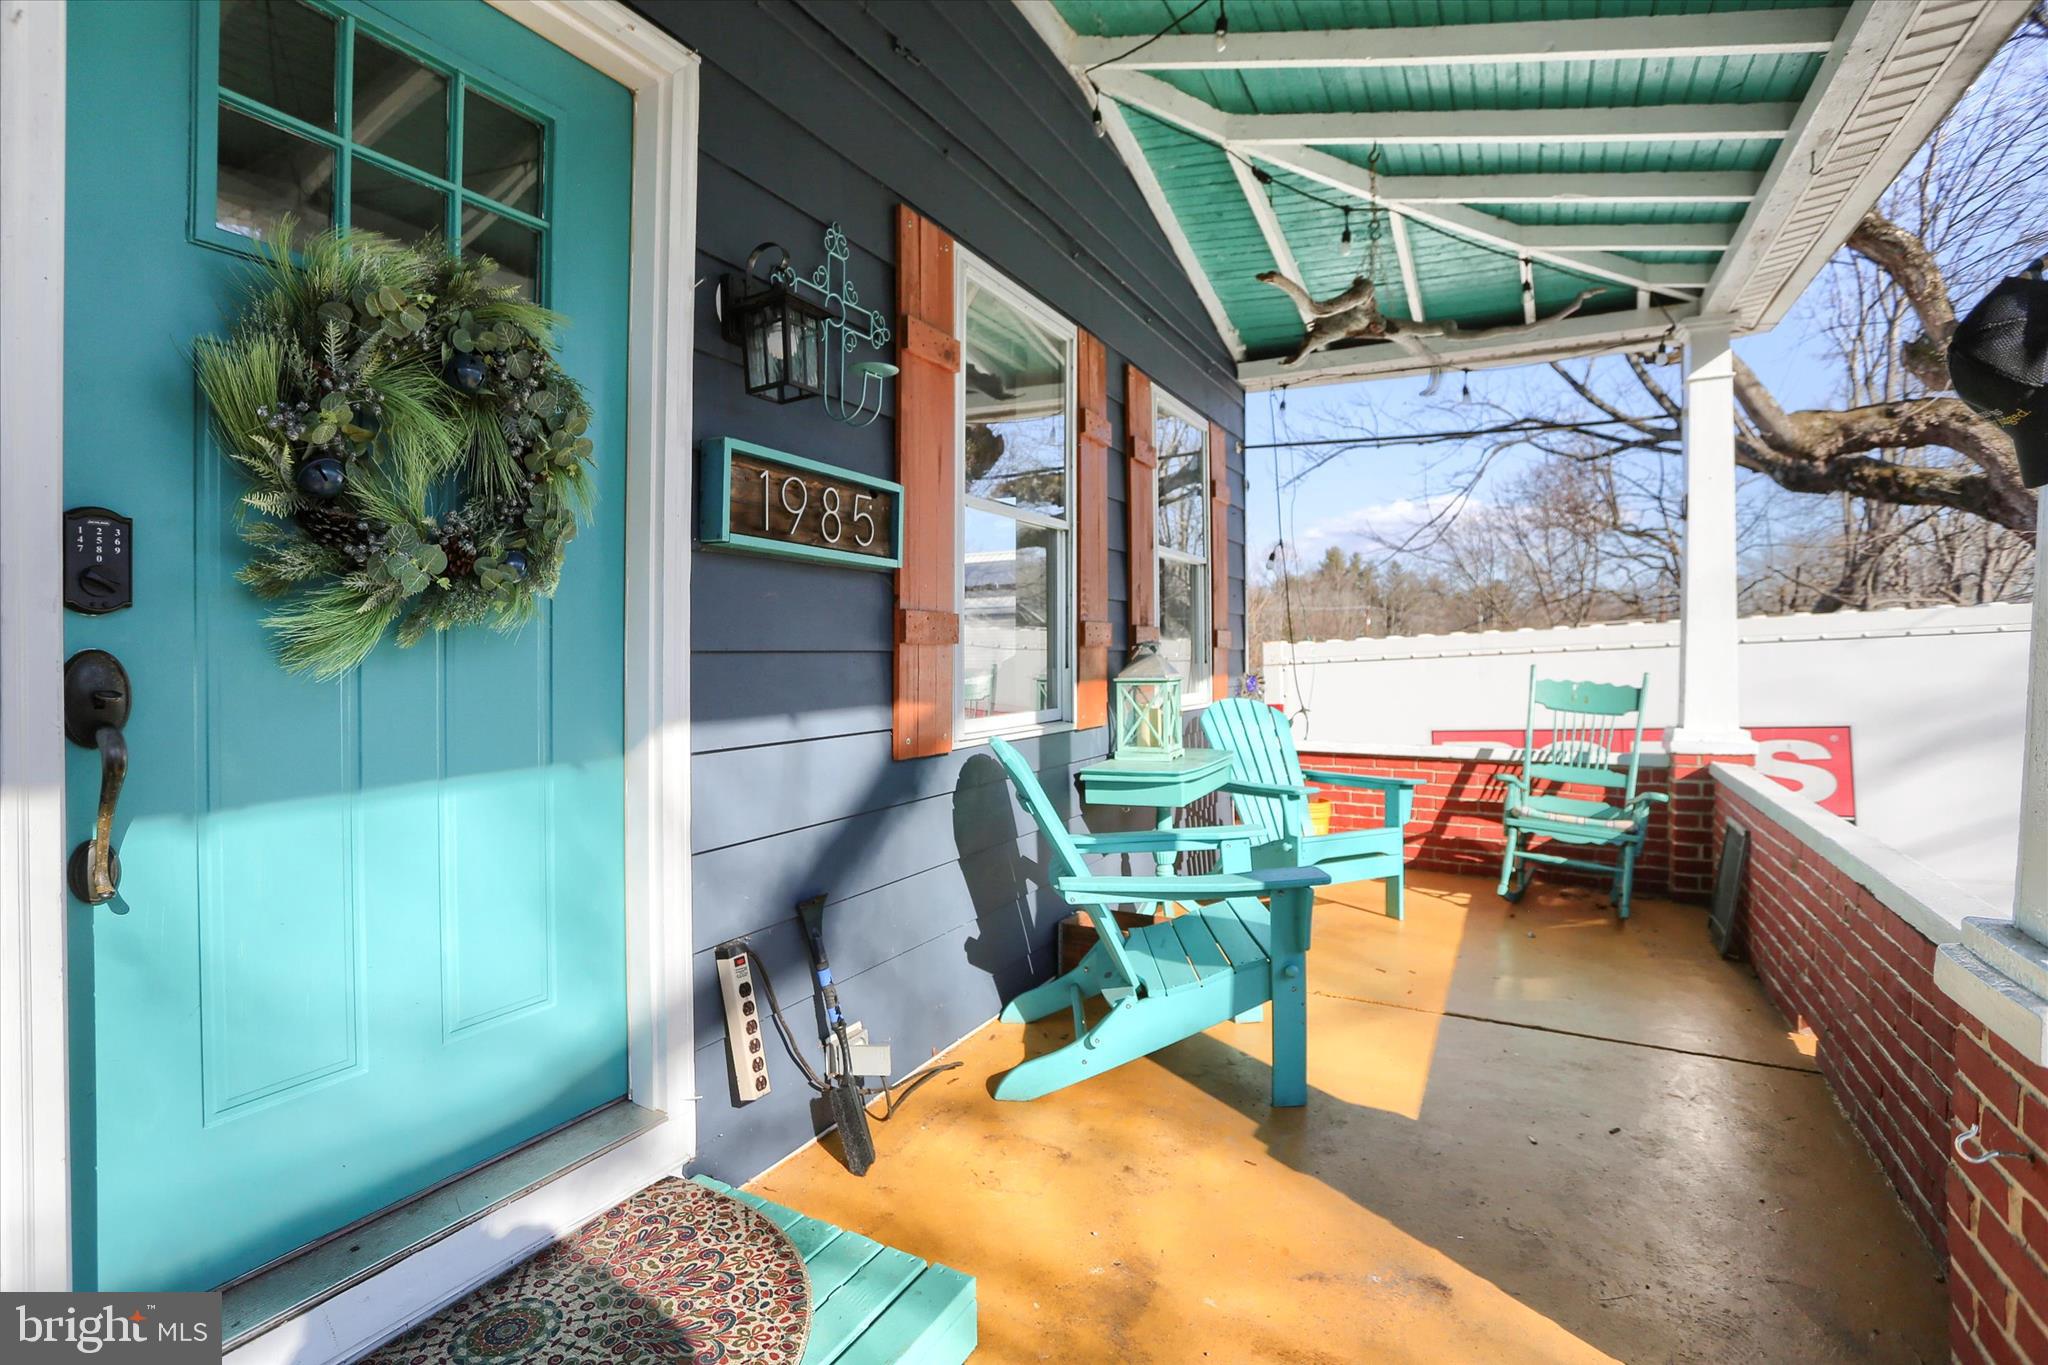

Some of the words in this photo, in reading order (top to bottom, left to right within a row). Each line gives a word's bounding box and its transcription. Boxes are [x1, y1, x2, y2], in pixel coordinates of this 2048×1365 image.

[760, 469, 875, 547] 1985
[96, 527, 103, 535] 2
[114, 529, 121, 537] 3
[77, 535, 83, 543] 4
[114, 538, 121, 546] 6
